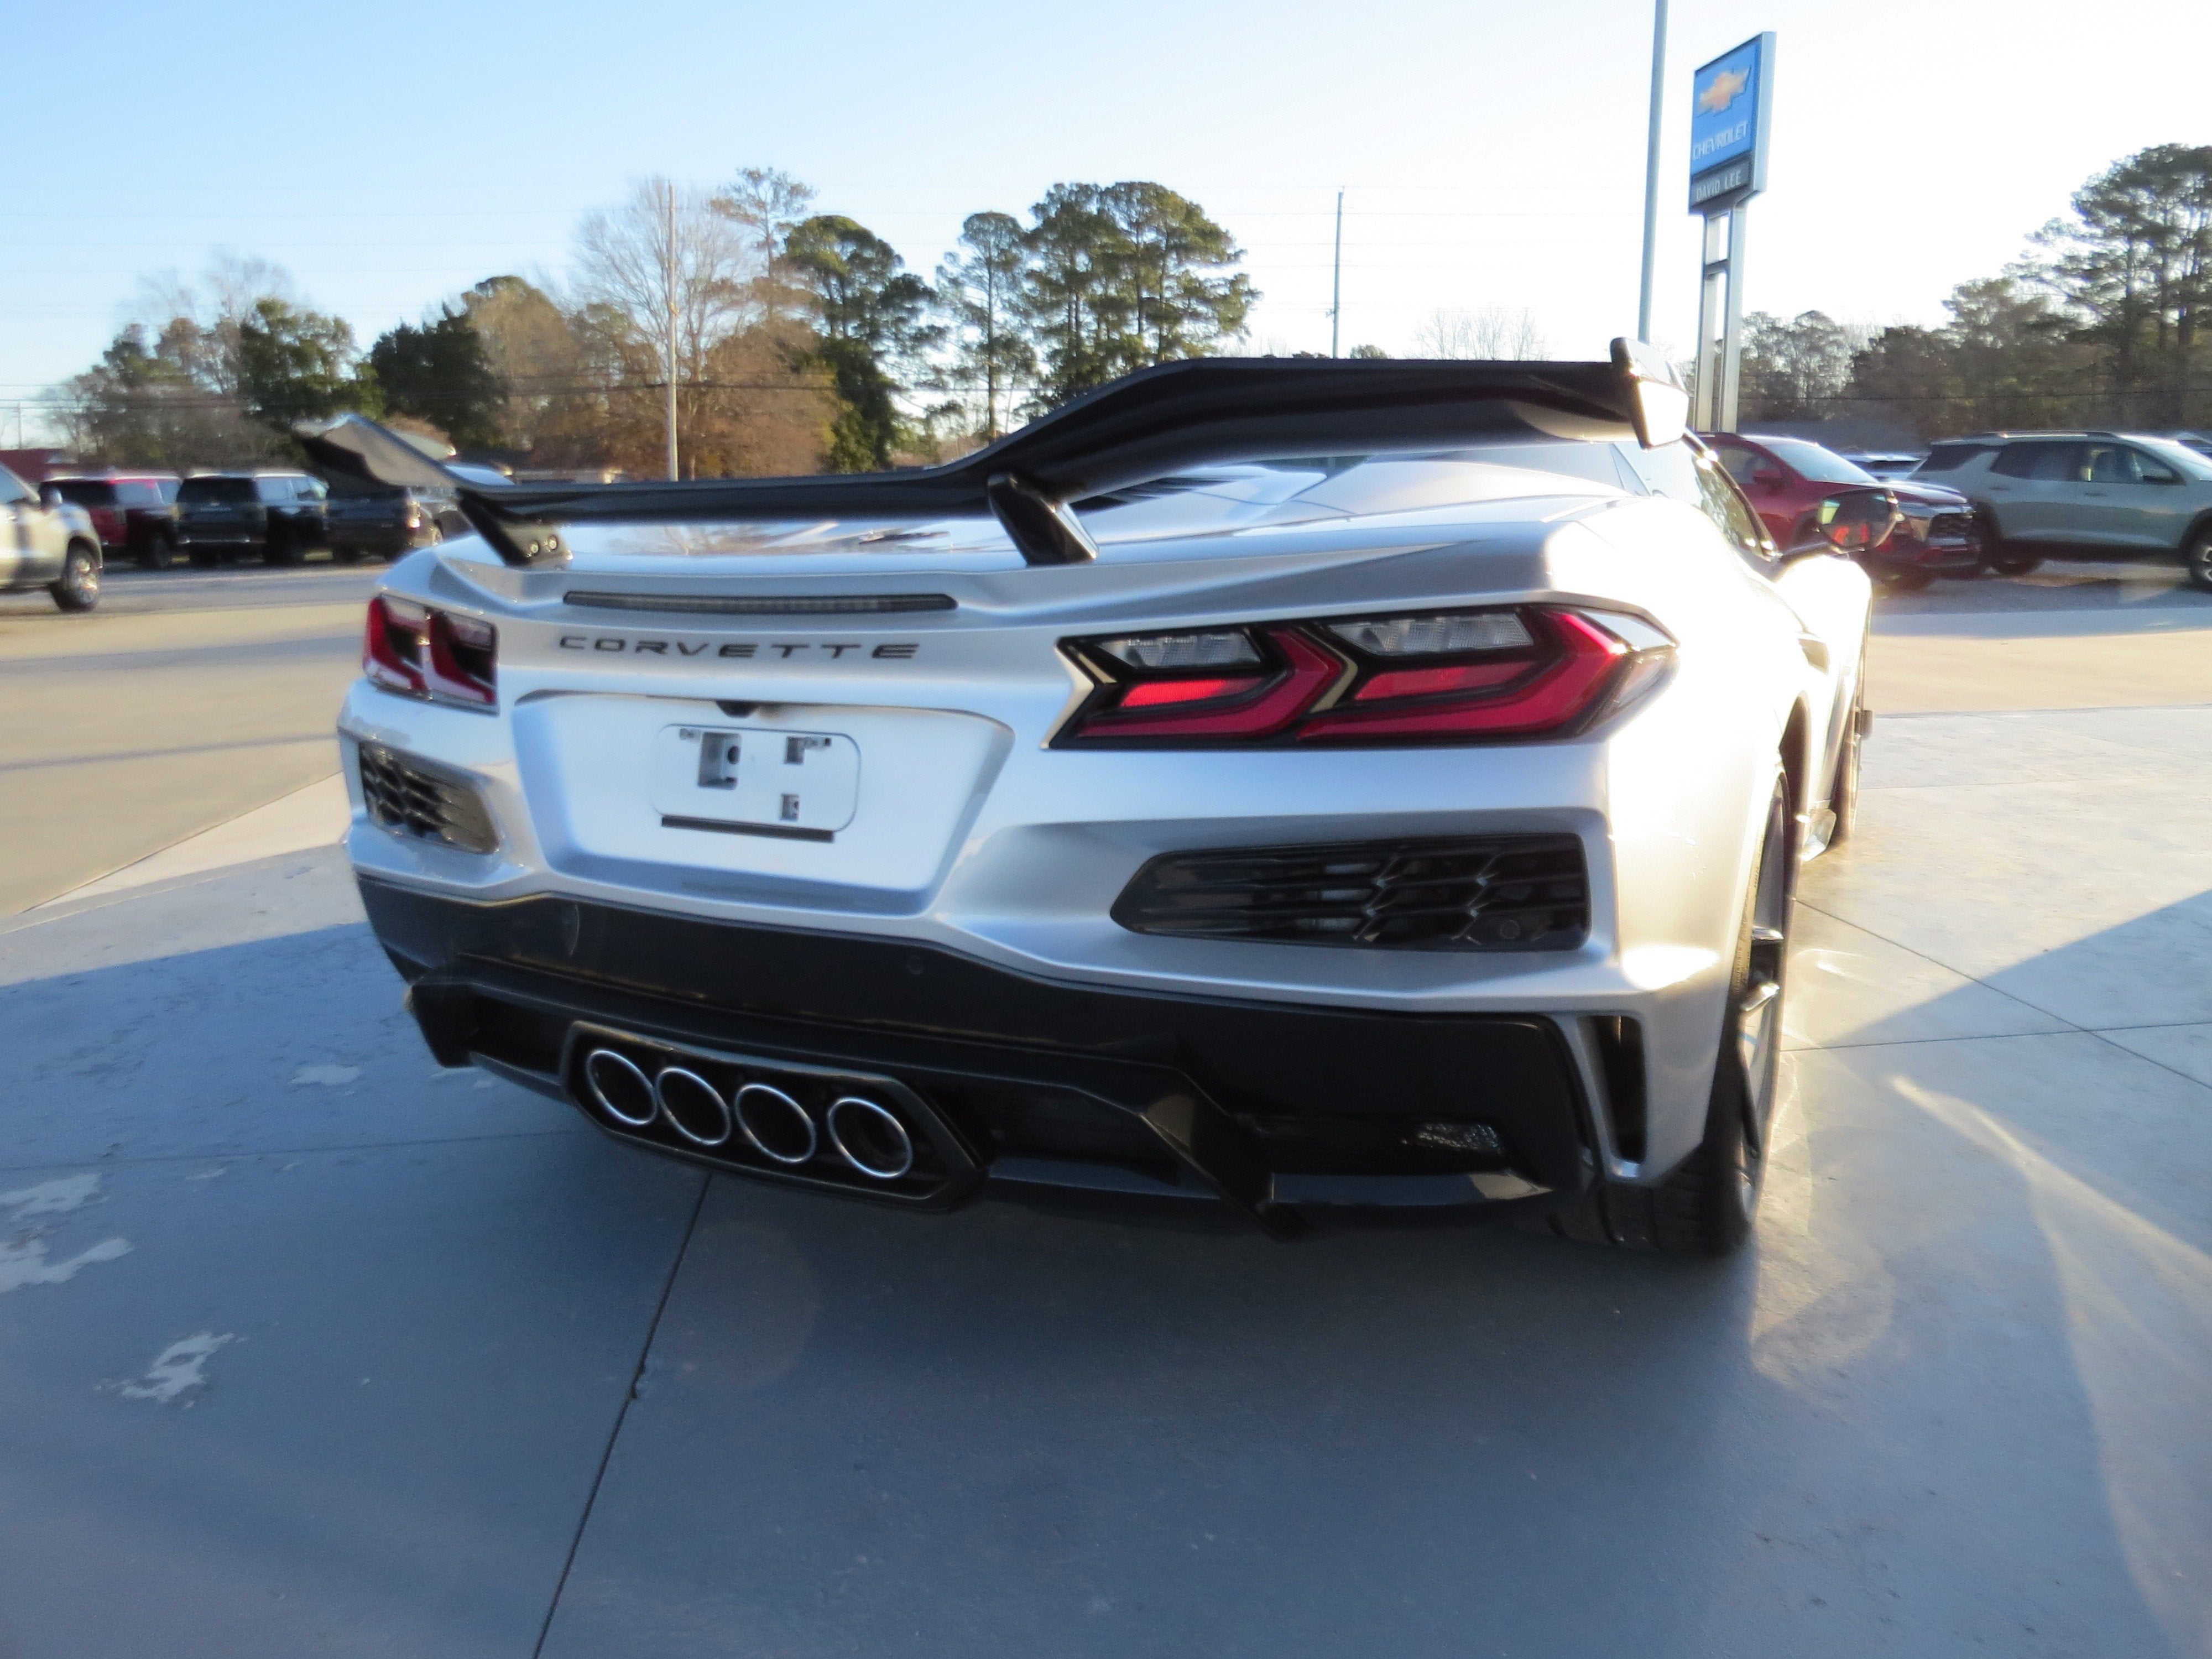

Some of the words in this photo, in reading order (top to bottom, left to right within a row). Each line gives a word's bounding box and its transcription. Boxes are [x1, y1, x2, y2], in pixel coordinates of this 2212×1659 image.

[1692, 121, 1747, 160] CHEVROLET
[1724, 170, 1741, 190] LEE
[560, 637, 920, 659] CORVETTE
